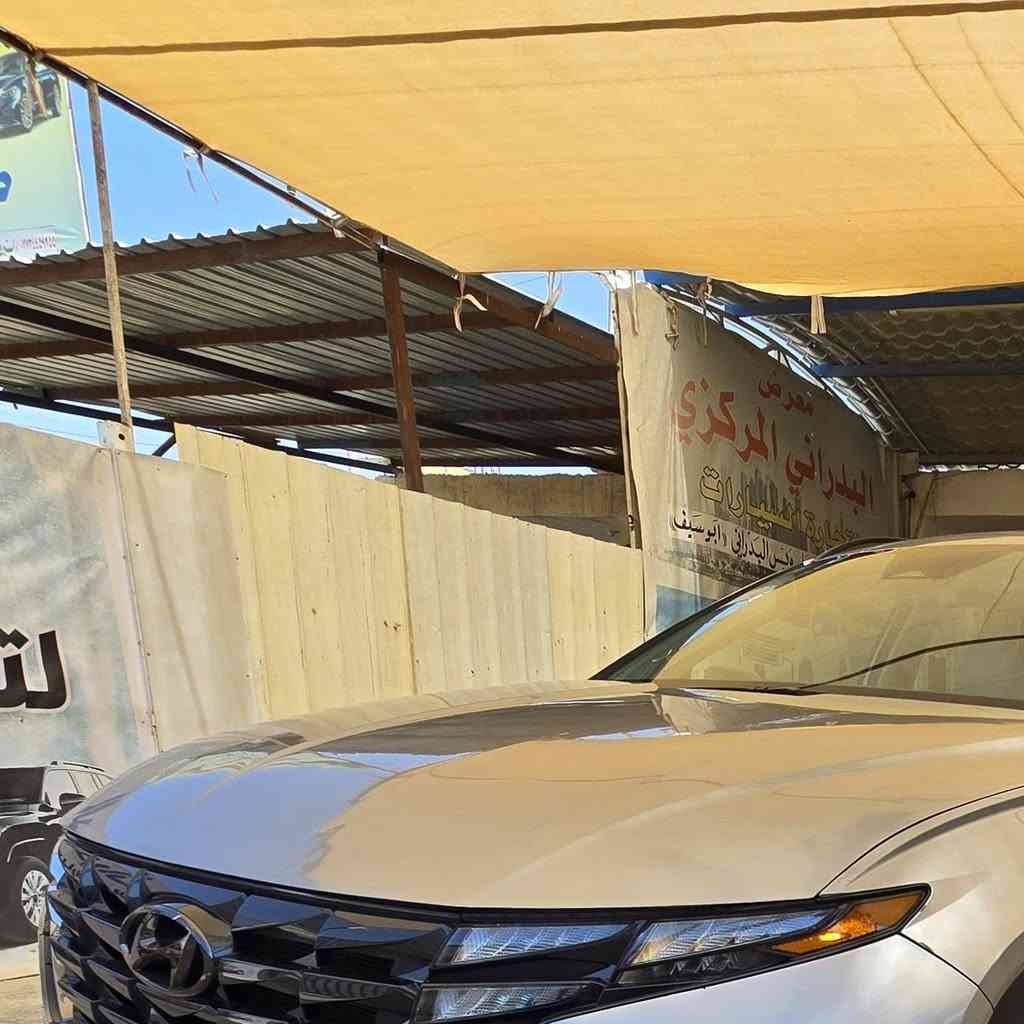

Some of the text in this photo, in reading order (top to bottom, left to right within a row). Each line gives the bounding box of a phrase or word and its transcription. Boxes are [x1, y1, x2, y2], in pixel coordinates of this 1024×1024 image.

[671, 378, 873, 515] البدراني المركزي
[0, 629, 67, 709] لت
